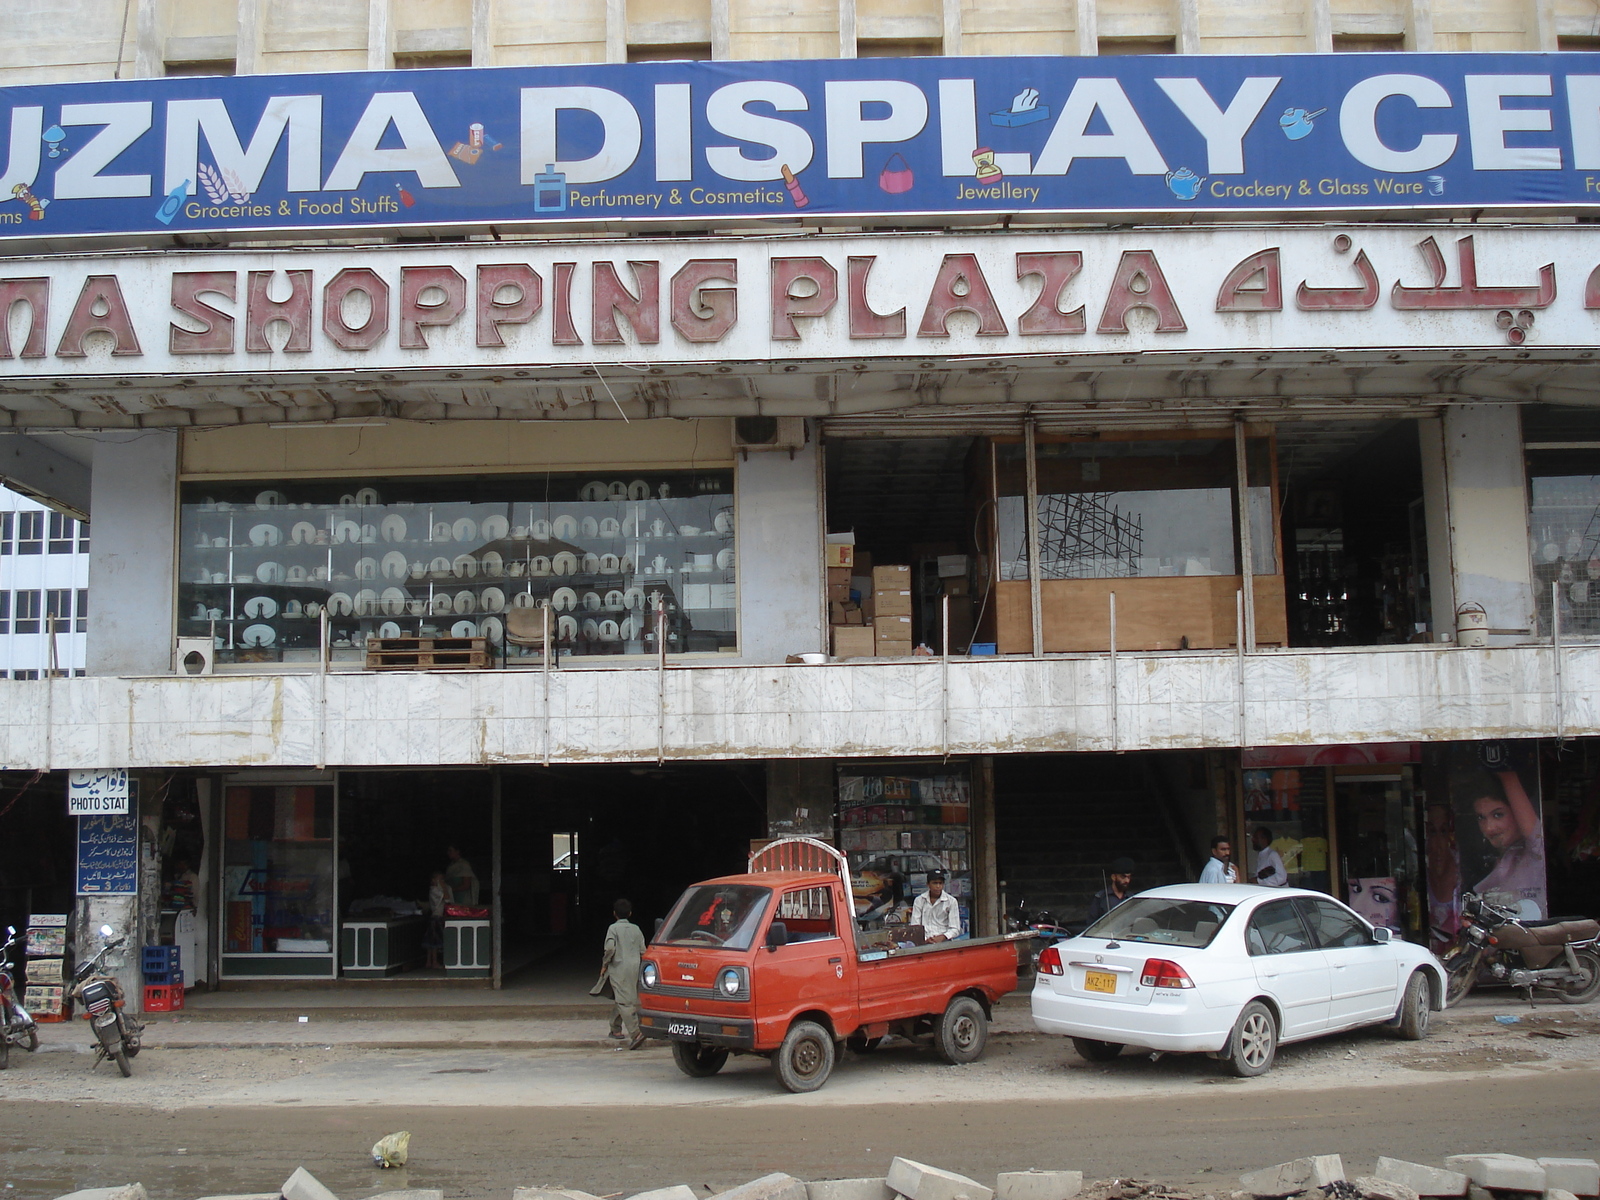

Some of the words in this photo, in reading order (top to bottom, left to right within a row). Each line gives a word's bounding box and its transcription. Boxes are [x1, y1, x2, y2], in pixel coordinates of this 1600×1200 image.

[520, 77, 1282, 185] DISPLAY
[570, 189, 662, 209] Perfumery
[669, 188, 683, 205] &
[690, 186, 784, 205] Cosmetics
[956, 182, 1040, 203] Jewellery
[1210, 181, 1293, 200] Crockery
[1298, 180, 1312, 195] &
[1318, 178, 1369, 195] Glass
[1374, 178, 1424, 195] Ware
[186, 202, 272, 219] Groceries
[278, 200, 292, 216] &
[298, 197, 344, 216] Food
[350, 194, 399, 214] Stuffs
[169, 258, 738, 354] SHOPPING
[771, 250, 1188, 339] PLAZA
[71, 797, 100, 810] PHOTO
[102, 797, 127, 810] STAT
[104, 881, 112, 891] 3
[1087, 977, 1115, 988] AKZ-117
